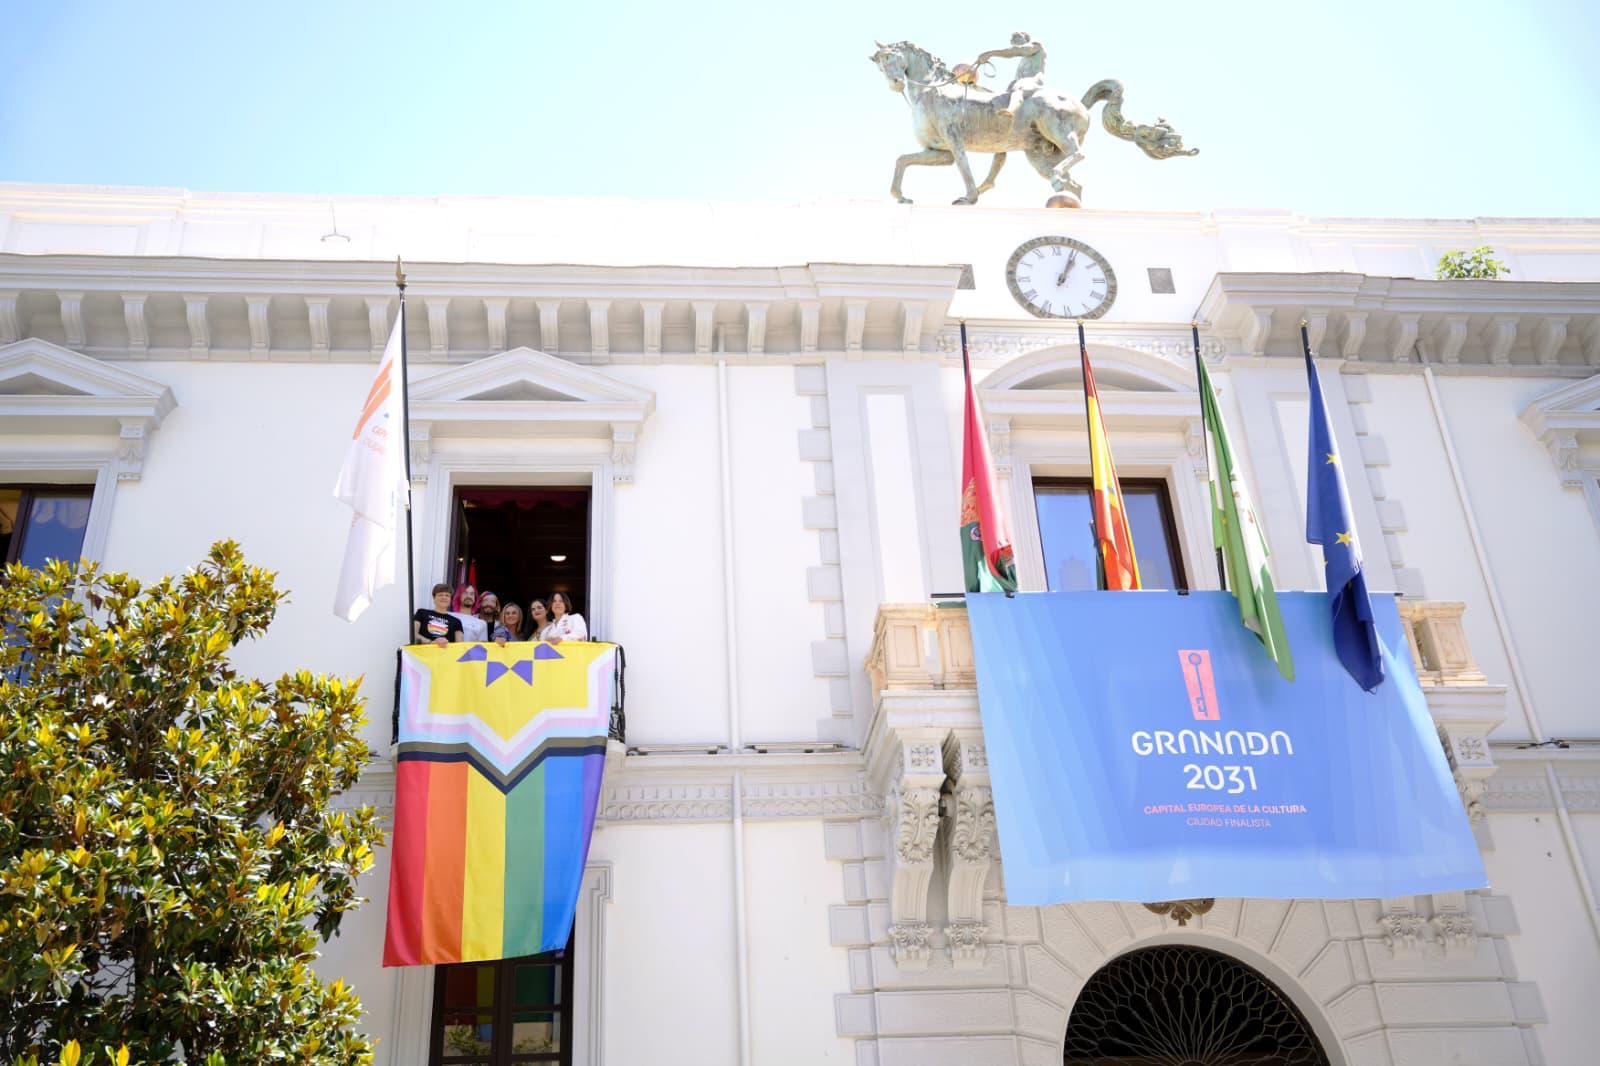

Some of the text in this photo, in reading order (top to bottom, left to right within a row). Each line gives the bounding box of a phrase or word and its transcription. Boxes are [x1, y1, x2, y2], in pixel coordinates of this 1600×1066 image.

[1131, 729, 1294, 756] GRANADA
[1183, 763, 1258, 794] 2031
[1144, 803, 1307, 814] CAPITAL EUROPEA DE LA CULTURA
[1186, 817, 1272, 828] CIUDAD FINALISTA
